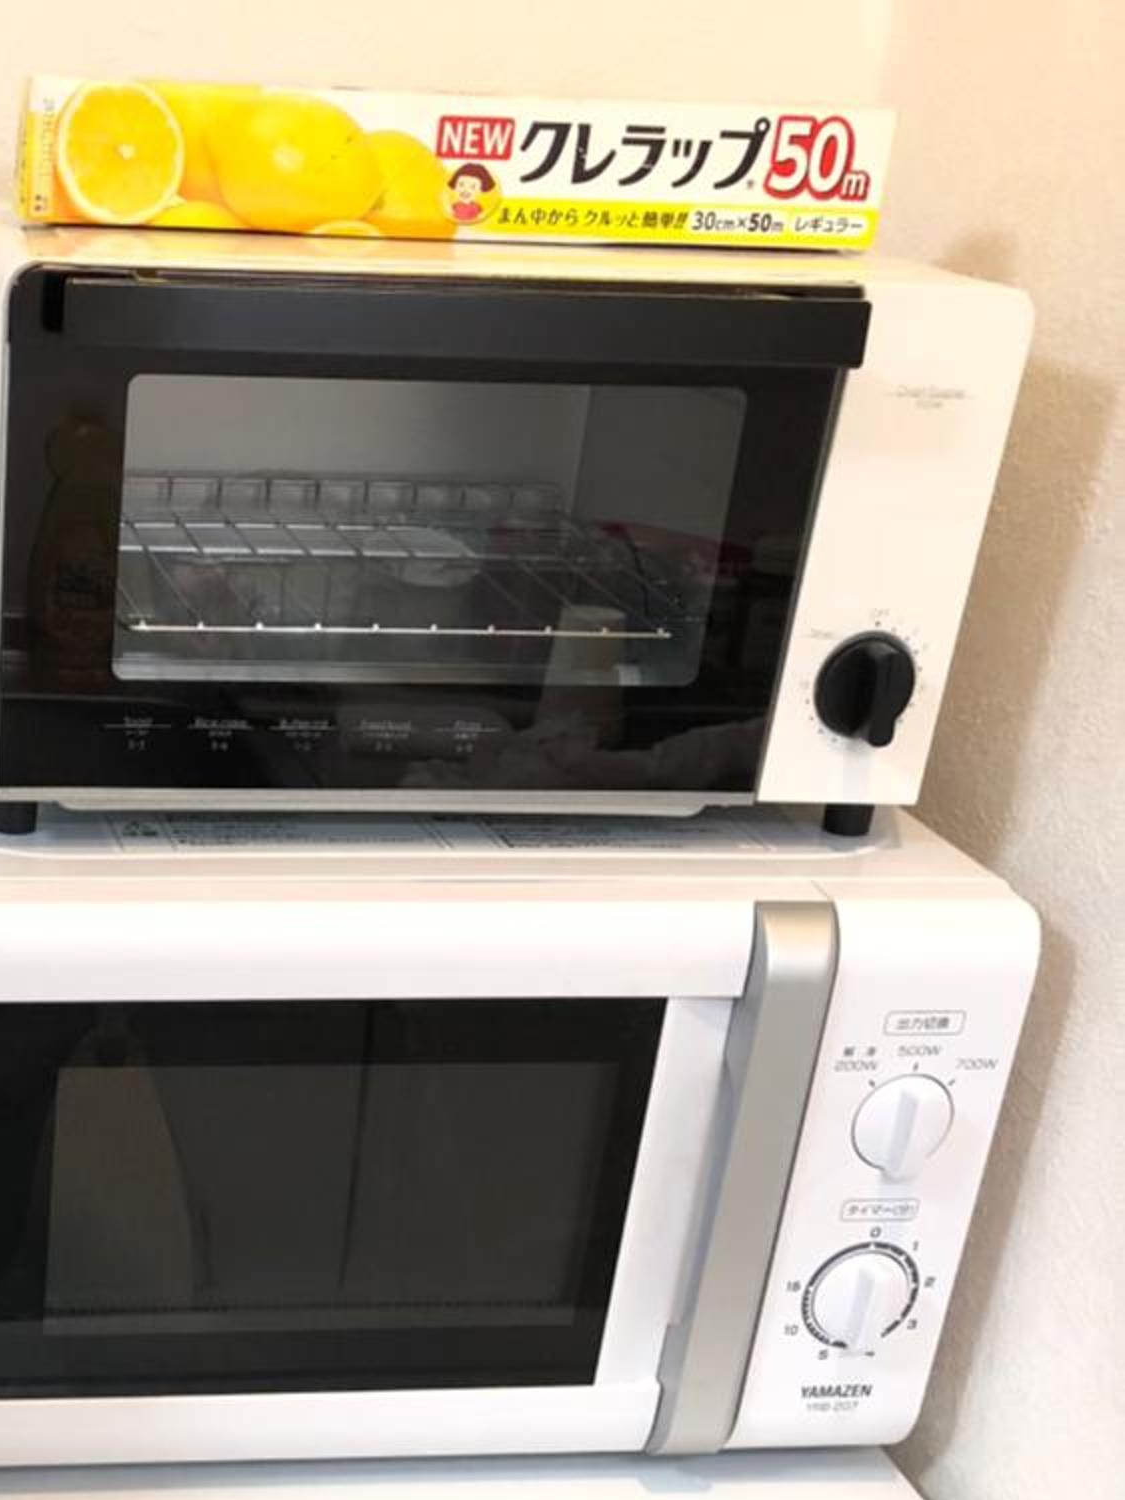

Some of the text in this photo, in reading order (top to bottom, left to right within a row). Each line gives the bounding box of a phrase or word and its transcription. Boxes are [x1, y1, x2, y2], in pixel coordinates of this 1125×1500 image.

[441, 120, 510, 158] NEW
[519, 117, 772, 188] クレラップ
[764, 118, 869, 198] 50m
[496, 208, 579, 227] まん中から
[793, 215, 865, 234] レギュラー
[897, 1045, 942, 1057] 500W
[869, 1226, 883, 1238] 0
[784, 1324, 799, 1336] 10
[801, 1384, 873, 1399] YAMAZEN
